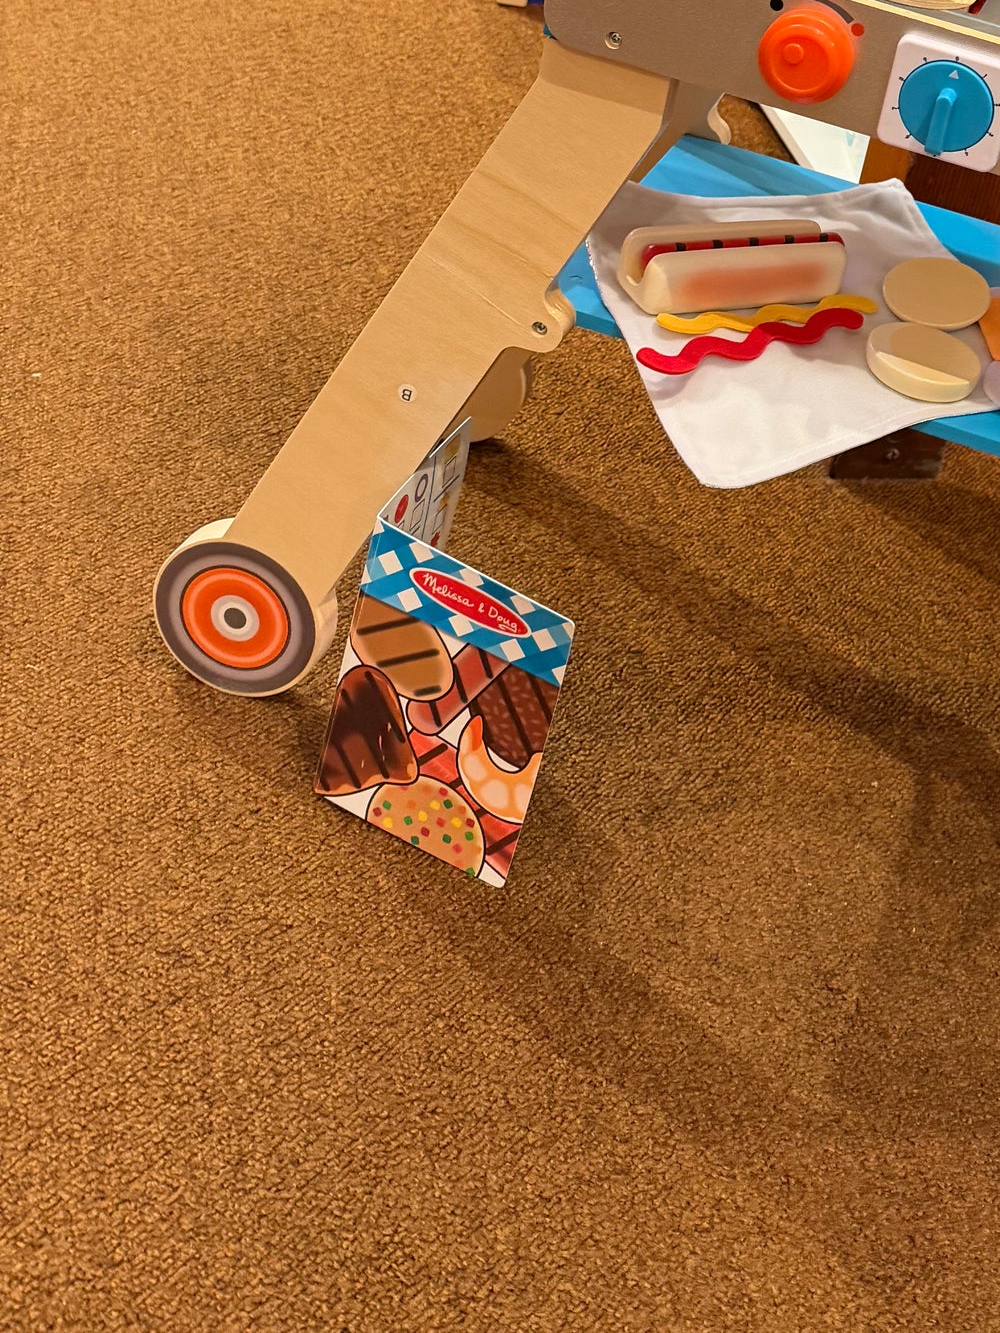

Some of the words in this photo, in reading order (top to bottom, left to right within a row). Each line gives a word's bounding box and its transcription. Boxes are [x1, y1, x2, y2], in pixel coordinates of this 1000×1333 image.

[402, 388, 413, 402] B
[422, 572, 474, 607] Melissa
[488, 606, 518, 633] Doug
